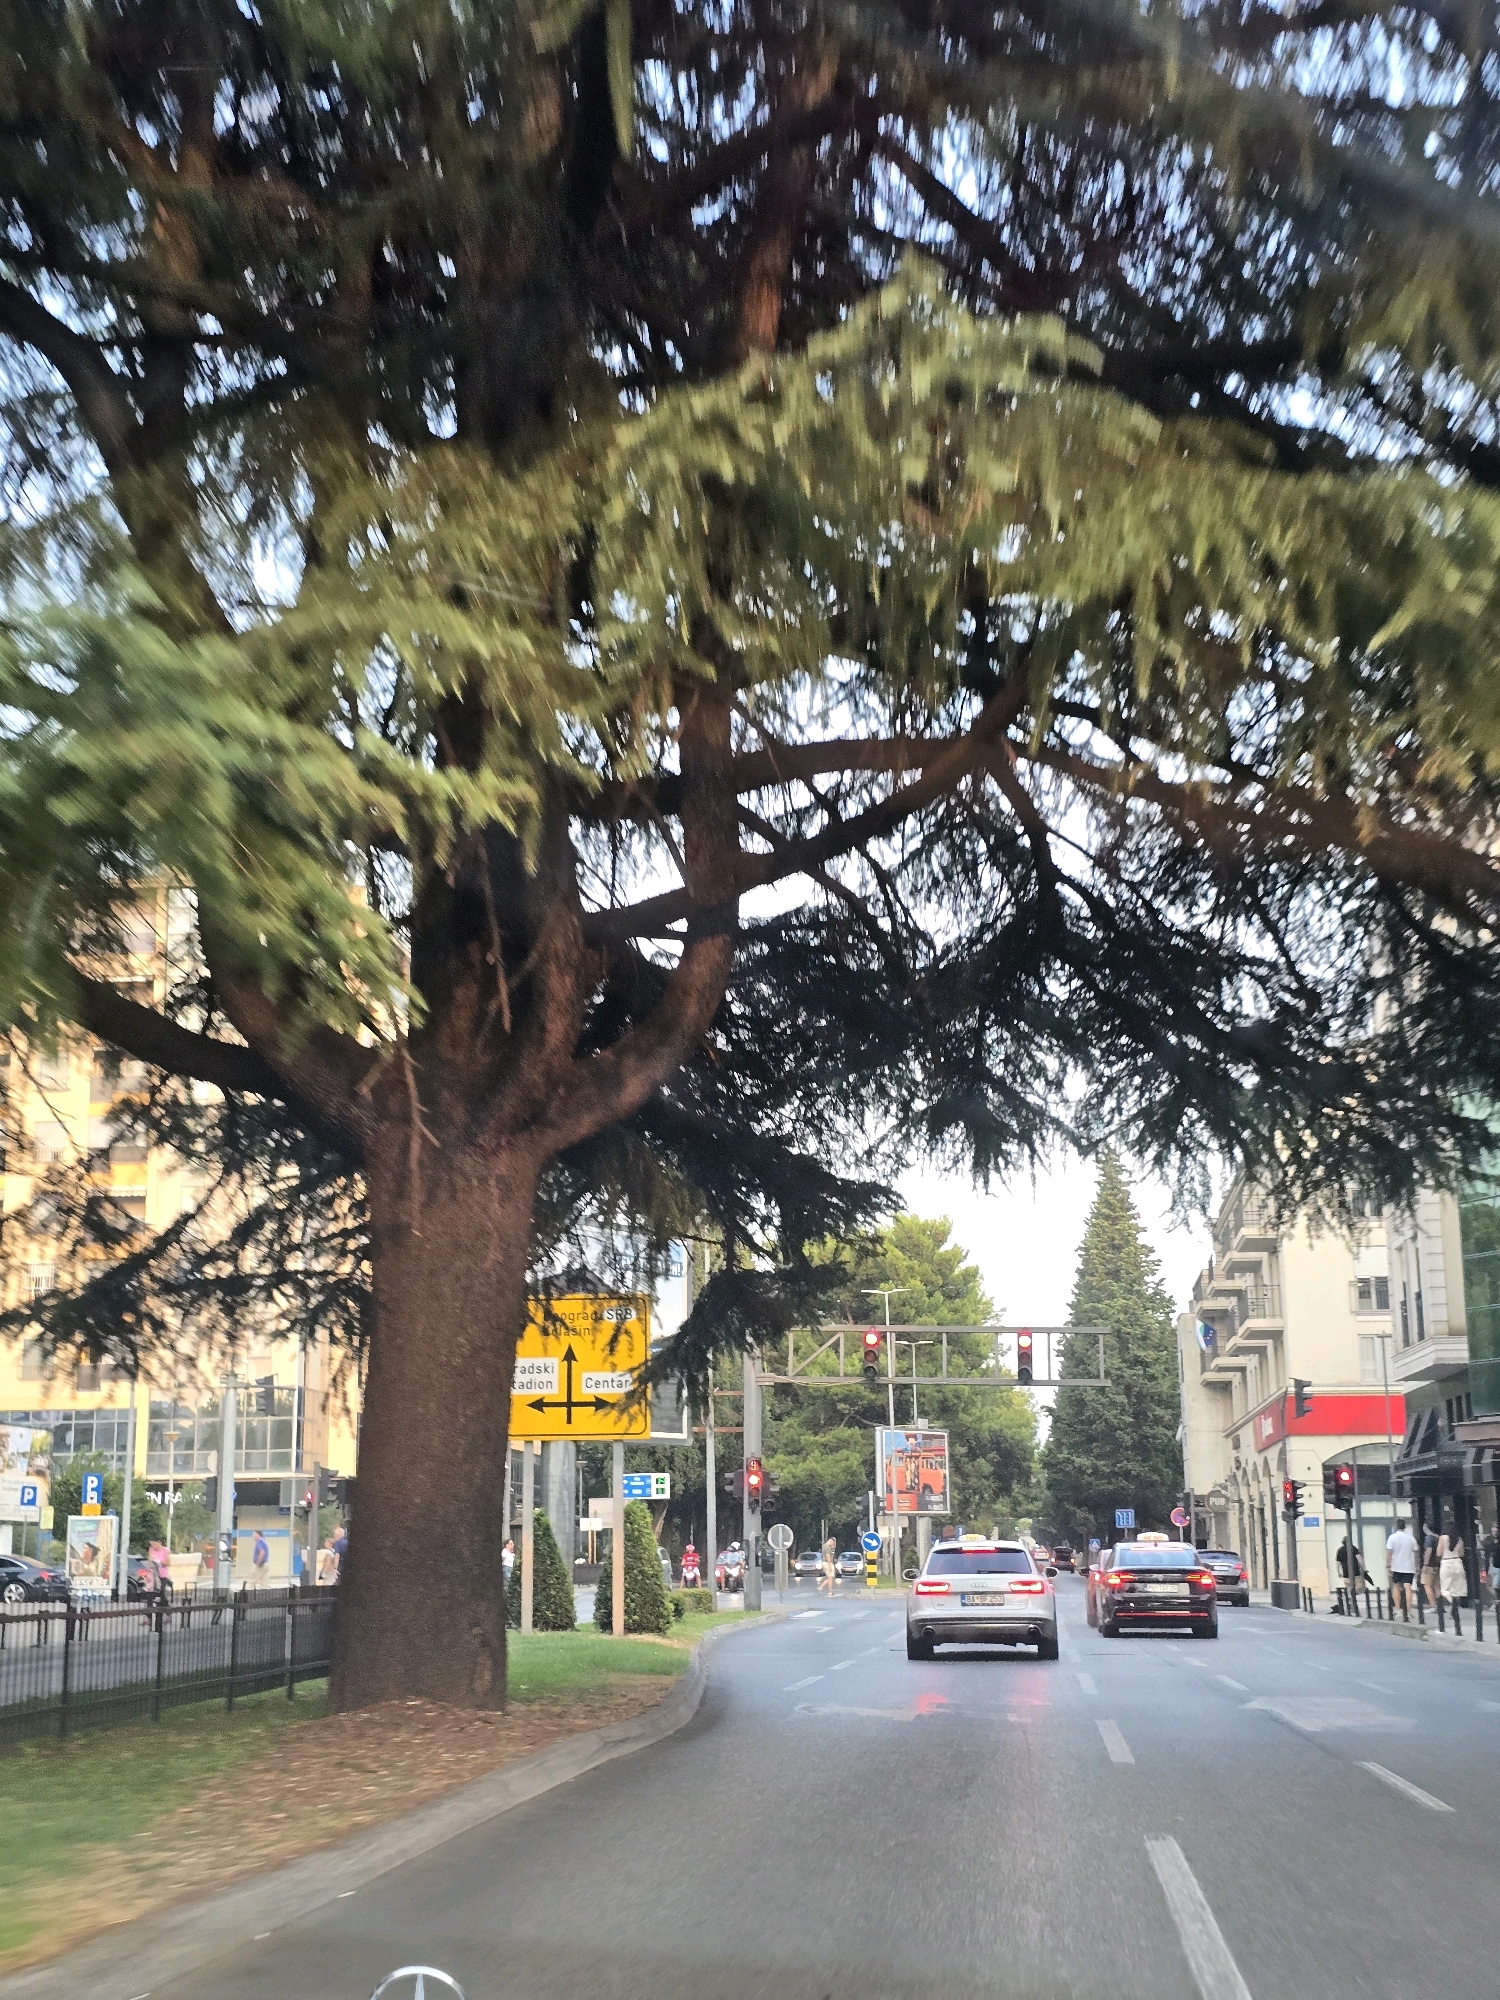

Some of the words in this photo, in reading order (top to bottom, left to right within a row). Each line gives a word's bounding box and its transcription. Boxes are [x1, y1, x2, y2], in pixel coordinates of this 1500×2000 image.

[542, 1324, 591, 1337] olašin
[514, 1363, 555, 1375] radski
[511, 1378, 553, 1390] tadion
[585, 1377, 630, 1389] Centar
[87, 1475, 98, 1492] P
[23, 1487, 34, 1504] P
[1209, 1497, 1226, 1506] PUB
